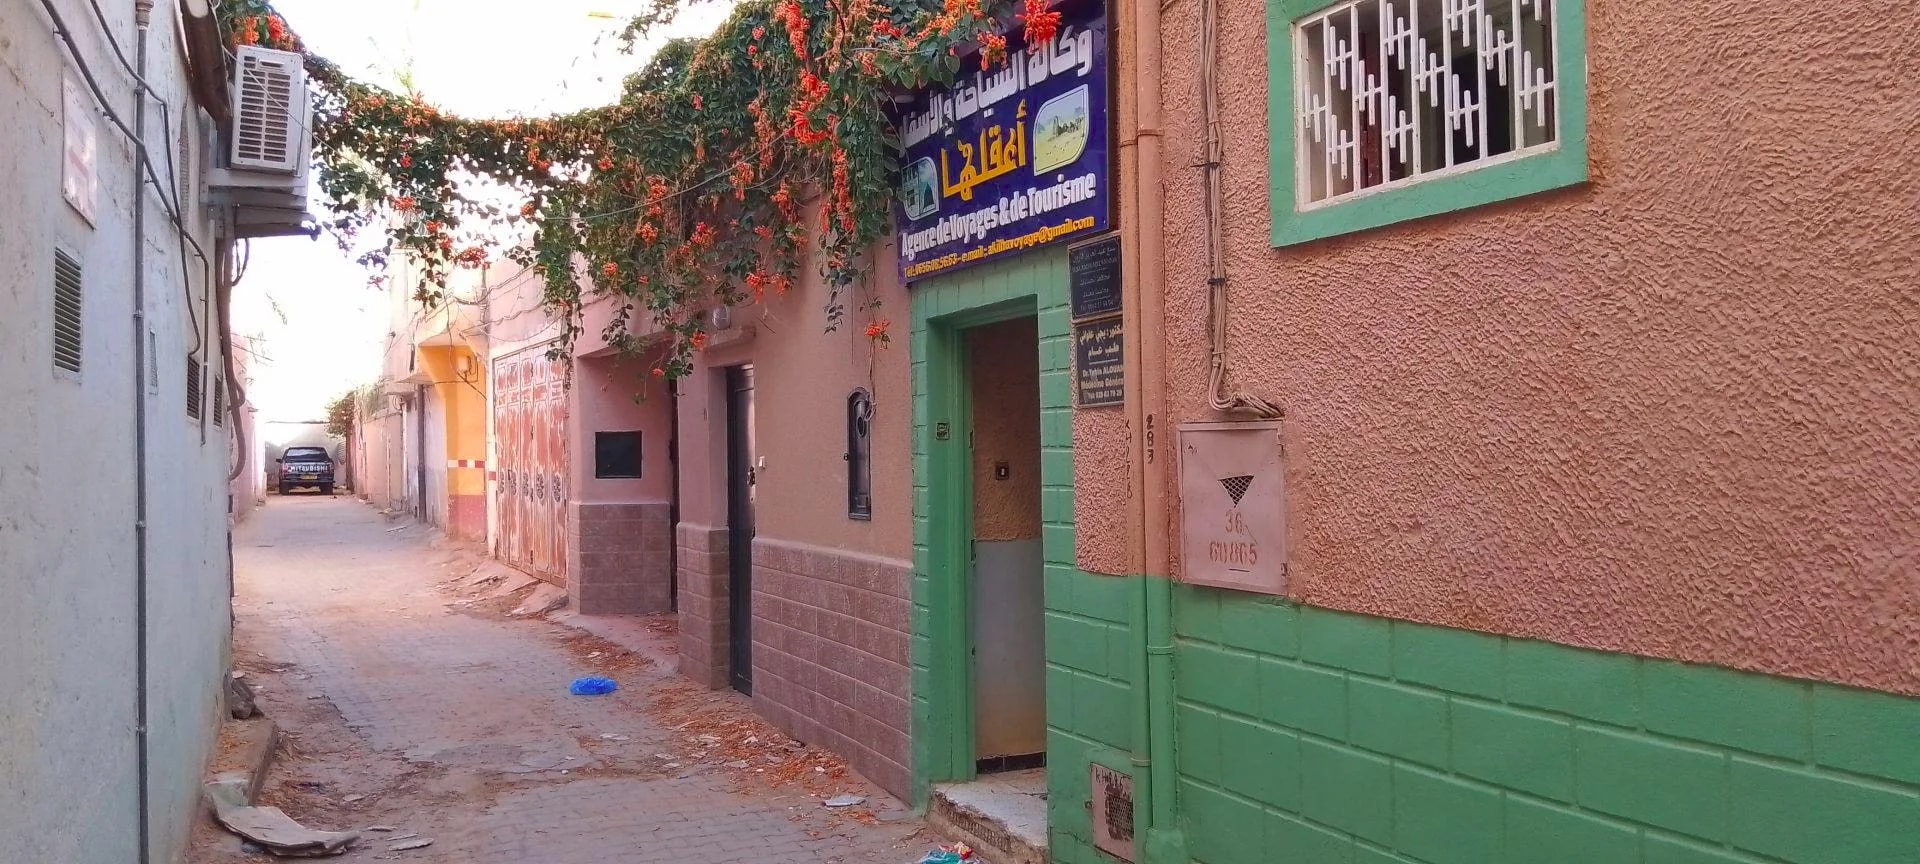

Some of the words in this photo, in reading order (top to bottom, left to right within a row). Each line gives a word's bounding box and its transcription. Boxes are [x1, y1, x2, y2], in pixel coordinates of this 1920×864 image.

[954, 49, 1026, 120] السياحة
[902, 226, 937, 261] Agence
[937, 217, 951, 245] de
[949, 204, 999, 244] Voyages
[999, 197, 1011, 226] &
[1010, 191, 1028, 222] de
[1027, 173, 1096, 216] Tourisme
[290, 464, 328, 472] MITSUBISHI
